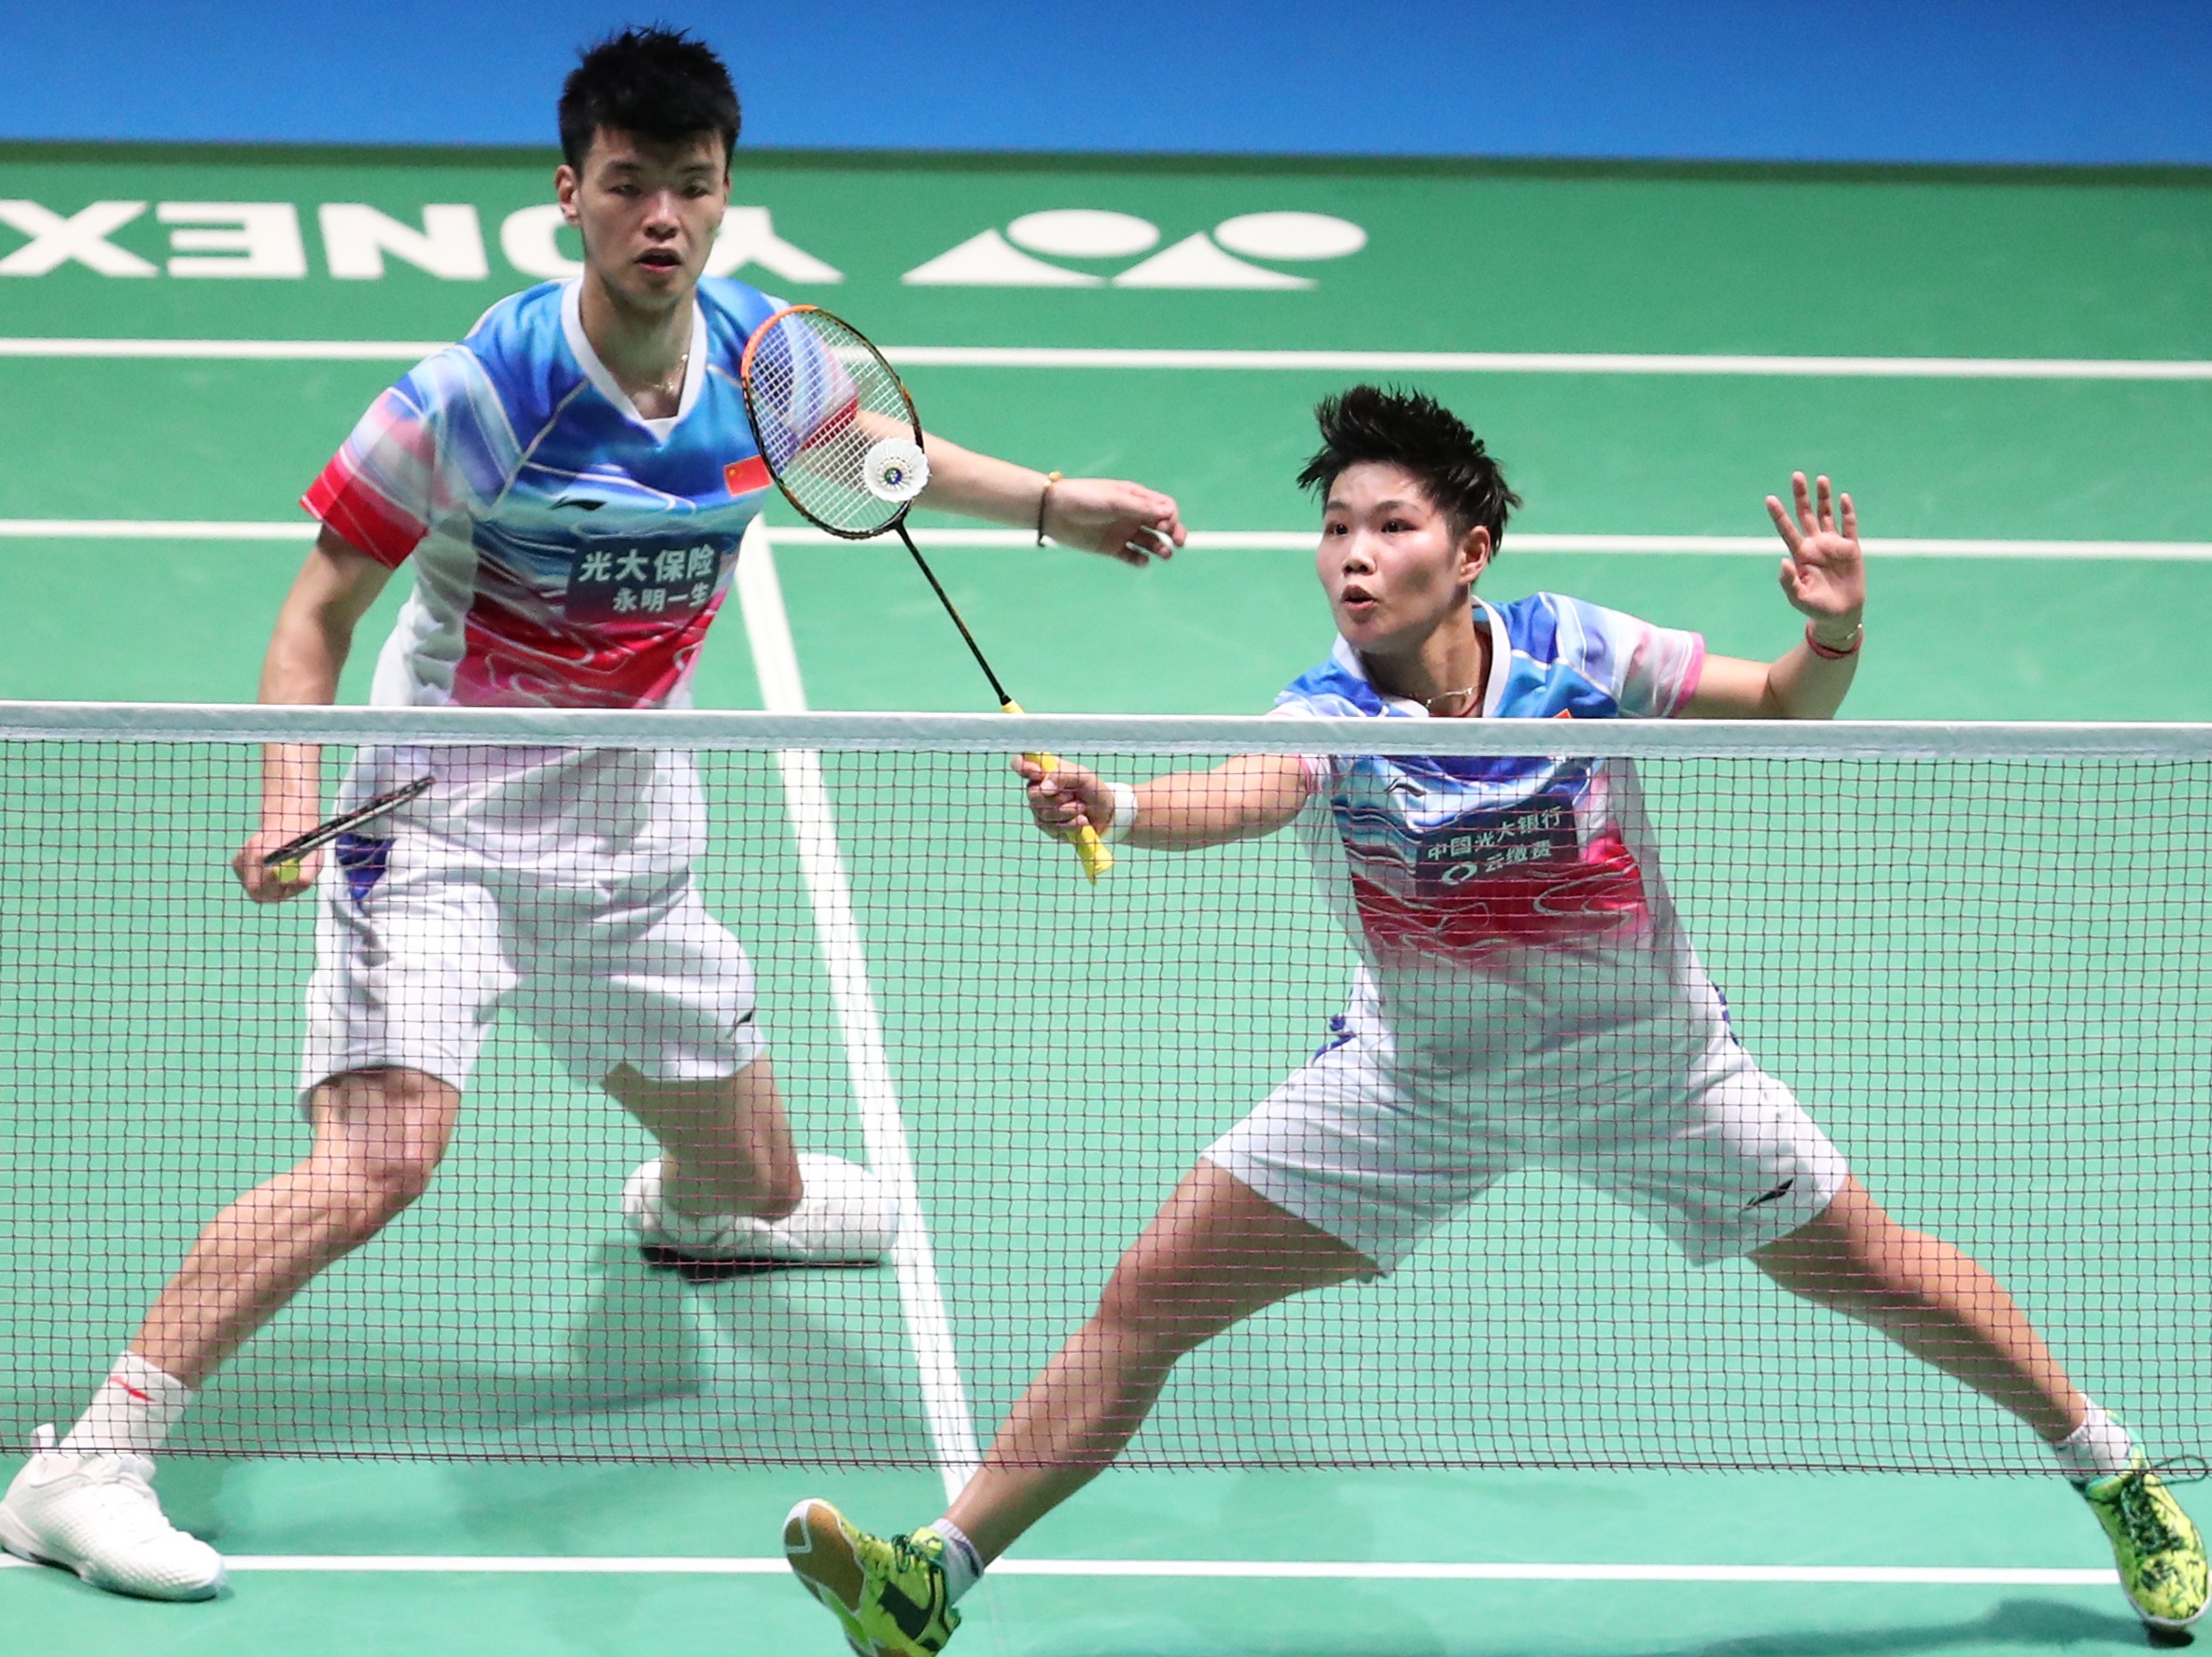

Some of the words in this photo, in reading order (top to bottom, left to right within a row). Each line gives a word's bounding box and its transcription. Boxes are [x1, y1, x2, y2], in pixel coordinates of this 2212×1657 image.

[578, 543, 715, 583] 光大保险
[612, 582, 709, 613] 永明一生
[1427, 806, 1562, 861] 中国光大银行
